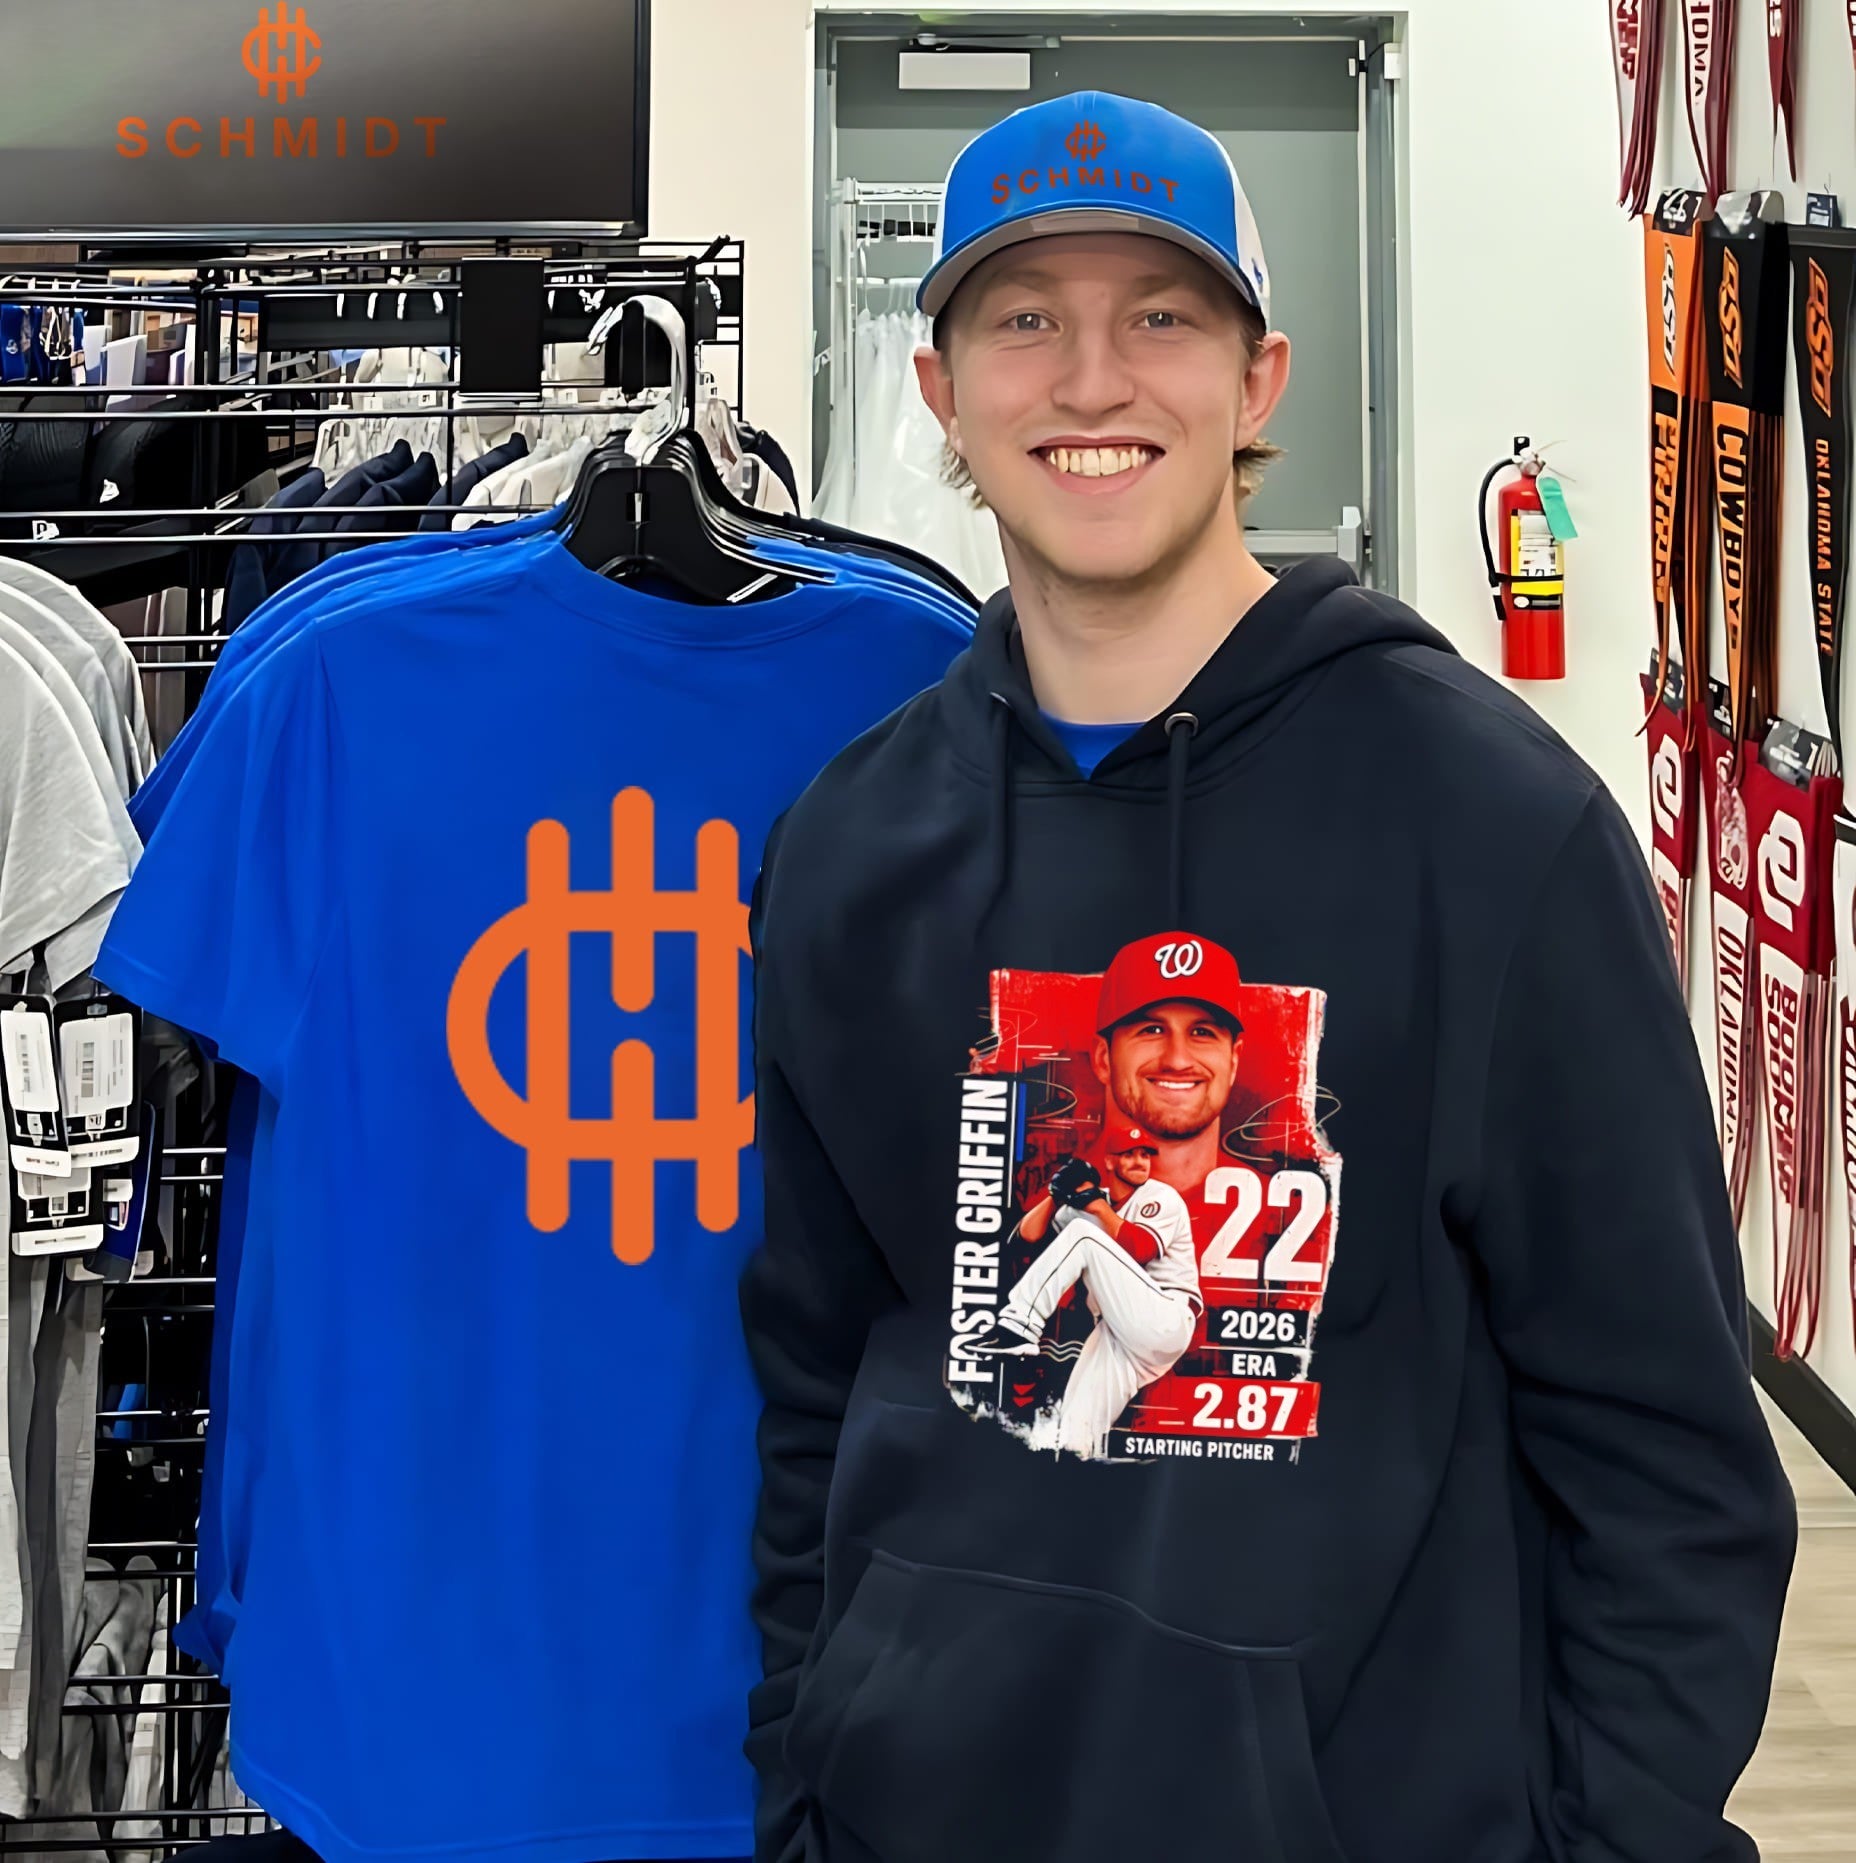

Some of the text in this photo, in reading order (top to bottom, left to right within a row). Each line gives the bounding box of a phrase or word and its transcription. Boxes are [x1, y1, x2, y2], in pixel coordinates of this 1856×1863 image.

[115, 116, 448, 160] SCHMIDT
[991, 166, 1180, 205] SCHMIDT
[1154, 939, 1205, 980] W
[1718, 926, 1744, 1144] OKLAHOMA
[949, 1079, 1008, 1383] FOSTER GRIFFIN
[1200, 1166, 1327, 1284] 22
[1220, 1310, 1296, 1342] 2026
[1231, 1353, 1277, 1377] ERA
[1192, 1382, 1299, 1432] 2.87
[1125, 1436, 1275, 1461] STARTING PITCHER
